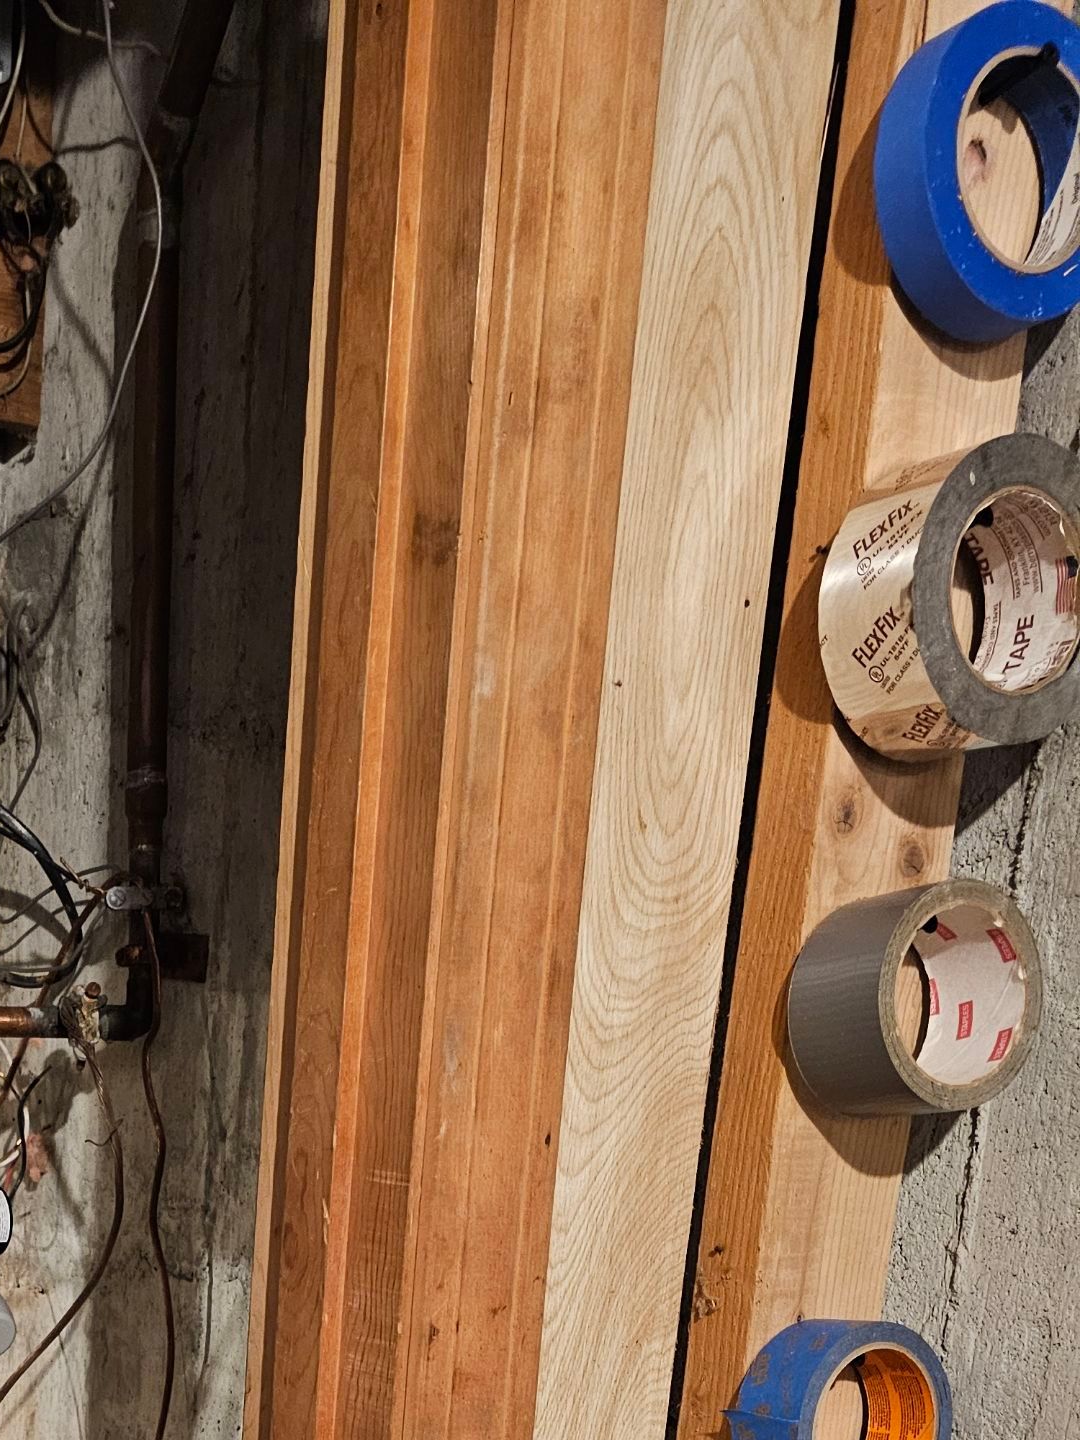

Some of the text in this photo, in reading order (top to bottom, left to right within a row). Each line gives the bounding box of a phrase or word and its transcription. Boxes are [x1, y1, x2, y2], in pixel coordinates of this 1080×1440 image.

[852, 499, 913, 560] FLEXFIX
[863, 574, 877, 591] FOR
[1011, 562, 1019, 576] AND
[852, 606, 901, 668] FLEXFIX
[1002, 614, 1034, 674] TAPE
[885, 681, 897, 695] FOR
[894, 661, 911, 682] CLASS
[902, 704, 942, 742] FLEXFIX
[960, 1004, 969, 1037] STAPLES
[993, 1030, 1009, 1058] STAPLES
